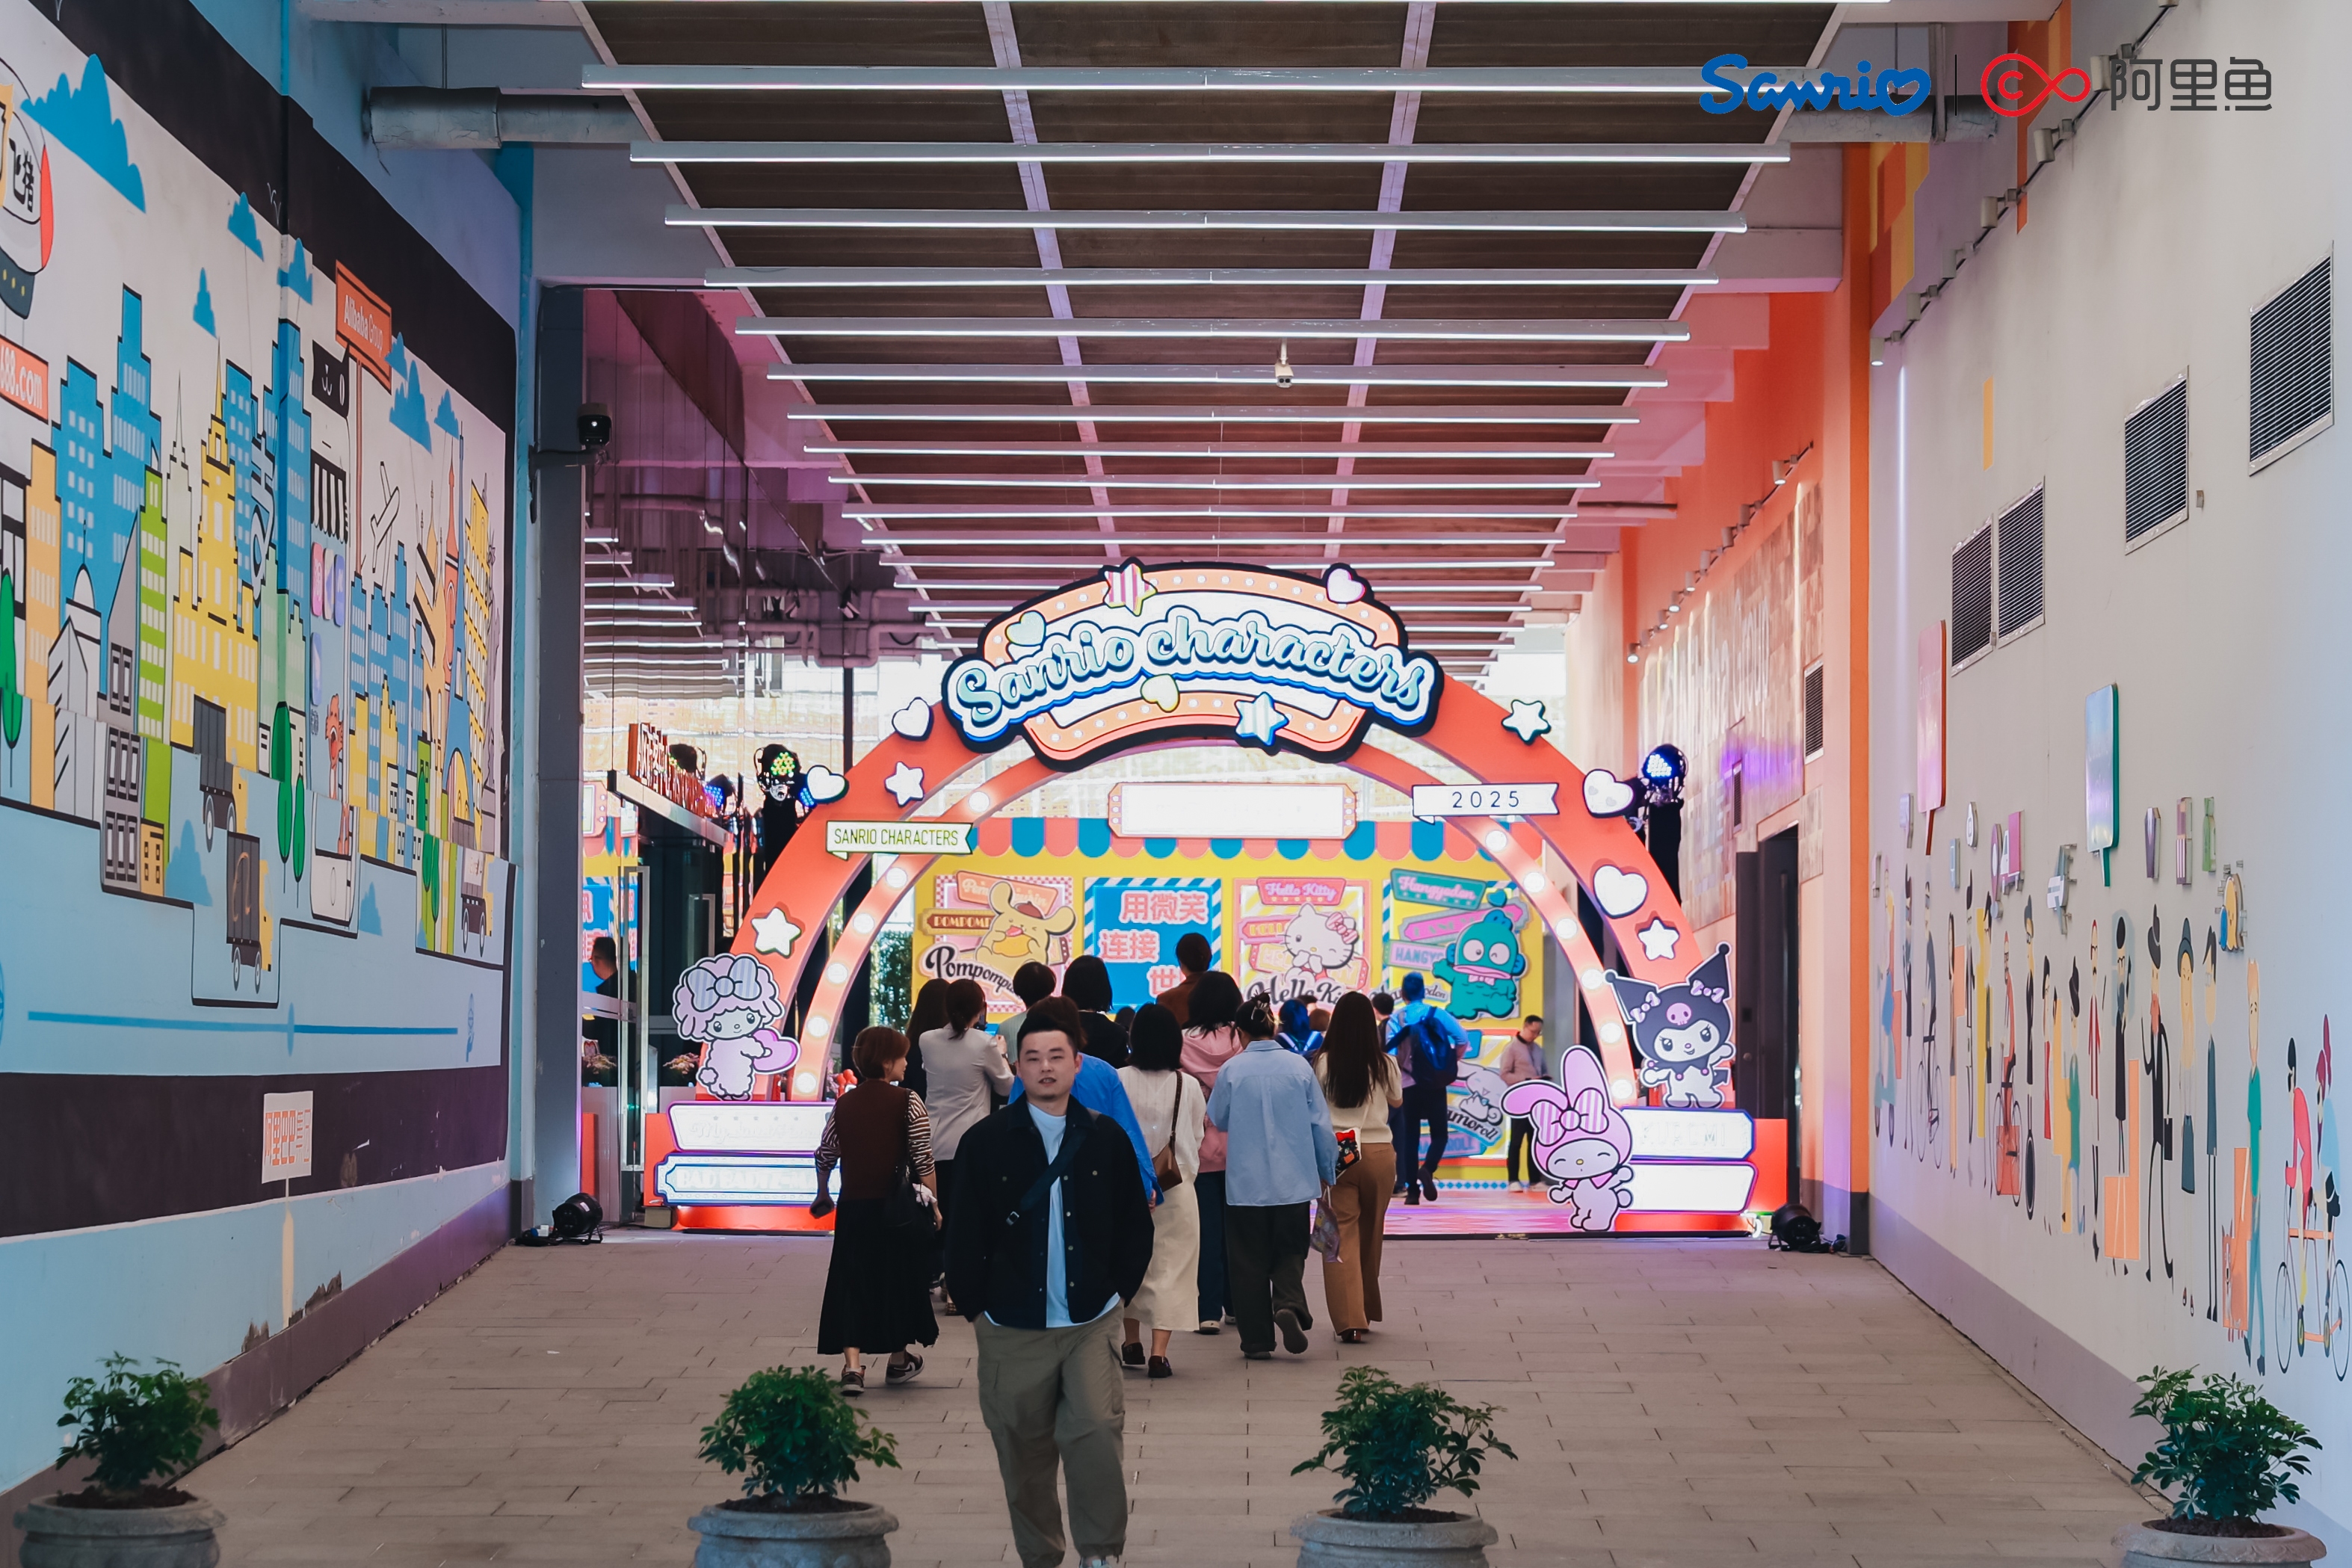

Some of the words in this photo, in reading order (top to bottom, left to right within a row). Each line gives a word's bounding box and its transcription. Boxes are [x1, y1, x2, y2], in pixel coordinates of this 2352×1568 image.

[344, 294, 368, 342] Alibaba
[368, 313, 383, 358] Group
[957, 629, 1137, 723] Sanrio
[1146, 613, 1428, 712] characters
[1732, 587, 1770, 738] Group
[1451, 790, 1520, 809] 2025
[834, 827, 877, 845] SANRIO
[880, 828, 959, 846] CHARACTERS
[1265, 882, 1301, 896] Hello
[1302, 883, 1337, 902] Kitty
[1122, 892, 1206, 922] 用微笑
[1101, 932, 1156, 960] 连接
